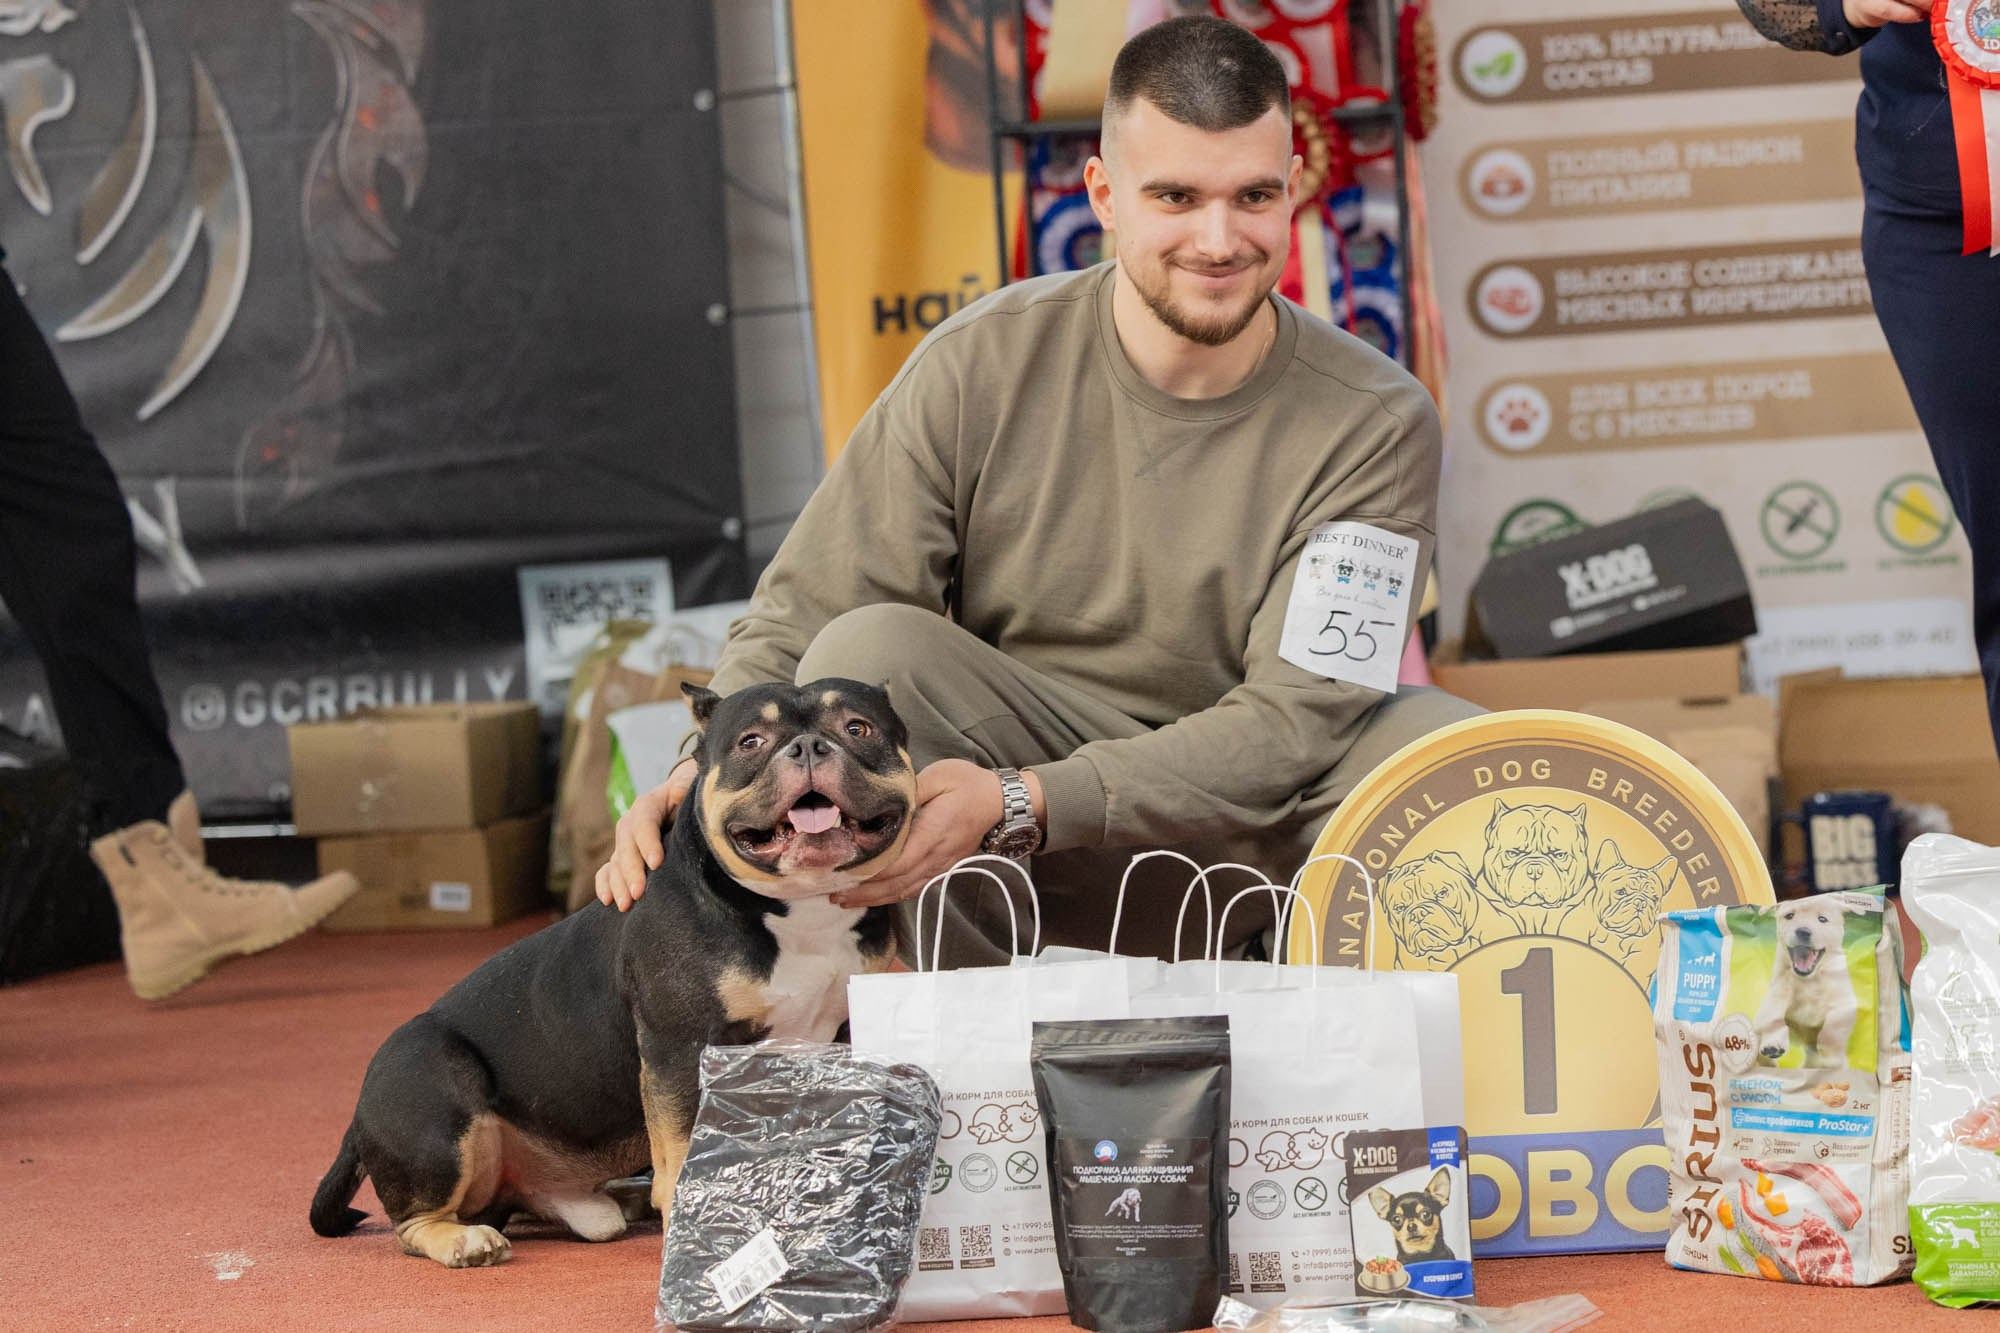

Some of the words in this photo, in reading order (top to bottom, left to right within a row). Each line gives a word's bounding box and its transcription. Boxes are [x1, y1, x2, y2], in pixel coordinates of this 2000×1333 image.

[1543, 58, 1652, 90] СОСТАВ
[1548, 141, 1678, 176] ПОЛНЫЙ
[1685, 136, 1803, 168] РАЦИОН
[1550, 172, 1691, 206] ПИТАНИЯ
[1555, 262, 1691, 296] ВЫСОКОЕ
[1556, 291, 1686, 324] МЯСНЫХ
[1569, 384, 1628, 412] ДЛЯ
[1633, 378, 1706, 406] ВСЕХ
[1713, 370, 1812, 400] ПОРОД
[1569, 415, 1592, 441] С
[1618, 404, 1756, 439] МЕСЯЦЕВ
[1315, 533, 1350, 545] BEST
[1308, 610, 1396, 662] 55
[1810, 814, 1876, 860] BIG
[1337, 791, 1446, 968] NATIONAL
[1474, 759, 1551, 789] DOG
[1684, 972, 1716, 990] PUPPY
[1500, 946, 1558, 1115] 1
[1724, 1036, 1750, 1052] 48%
[956, 1091, 981, 1100] КОРМ
[984, 1090, 1003, 1099] ДЛЯ
[1852, 1100, 1859, 1109] 2
[1860, 1102, 1870, 1110] кг
[1242, 1120, 1268, 1129] КОРМ
[1270, 1119, 1290, 1128] ДЛЯ
[1292, 1116, 1323, 1126] СОБАК
[1335, 1112, 1369, 1122] КОШЕК
[1682, 1042, 1724, 1243] SIRIUS
[1073, 1166, 1120, 1175] ПОДКОРМКА
[1121, 1166, 1138, 1175] ДЛЯ
[1138, 1165, 1194, 1174] НАРАЩИВАНИЯ
[1080, 1174, 1121, 1183] МЫШЕЧНОЙ
[1123, 1175, 1152, 1183] МАССЫ
[1153, 1175, 1159, 1183] У
[1160, 1174, 1187, 1183] СОБАК
[1043, 1221, 1053, 1229] 65
[1014, 1235, 1054, 1243] info@perro
[1333, 1247, 1350, 1255] 658-
[1303, 1261, 1353, 1269] info@perroga
[1304, 1273, 1354, 1282] www.perroga
